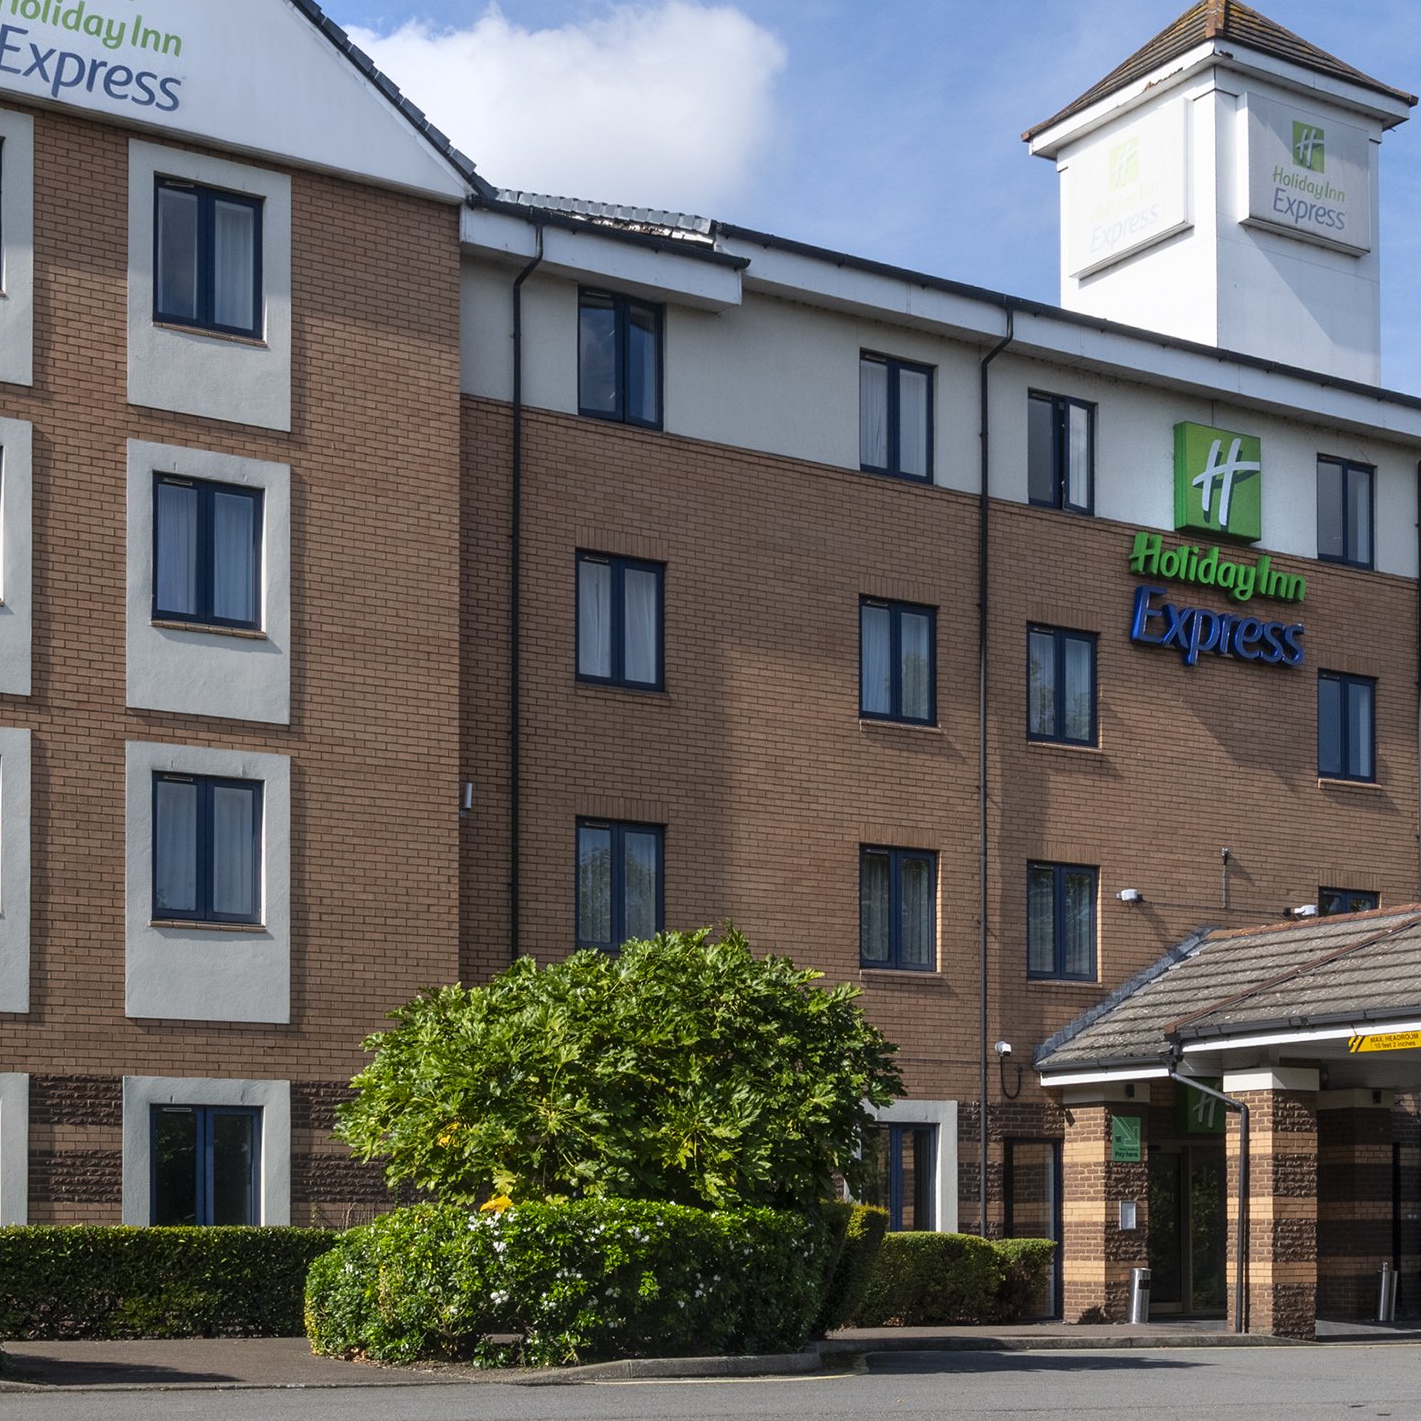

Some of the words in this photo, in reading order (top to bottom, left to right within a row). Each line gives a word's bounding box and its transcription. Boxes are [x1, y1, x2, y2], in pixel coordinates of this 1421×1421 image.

[131, 14, 183, 57] Inn
[1272, 165, 1324, 200] Holiday
[1325, 181, 1345, 203] Inn
[1273, 187, 1346, 230] Express
[1129, 531, 1256, 601] Holiday
[1256, 555, 1307, 602] Inn
[1130, 584, 1306, 666] Express
[1385, 1033, 1420, 1042] HEADROOM
